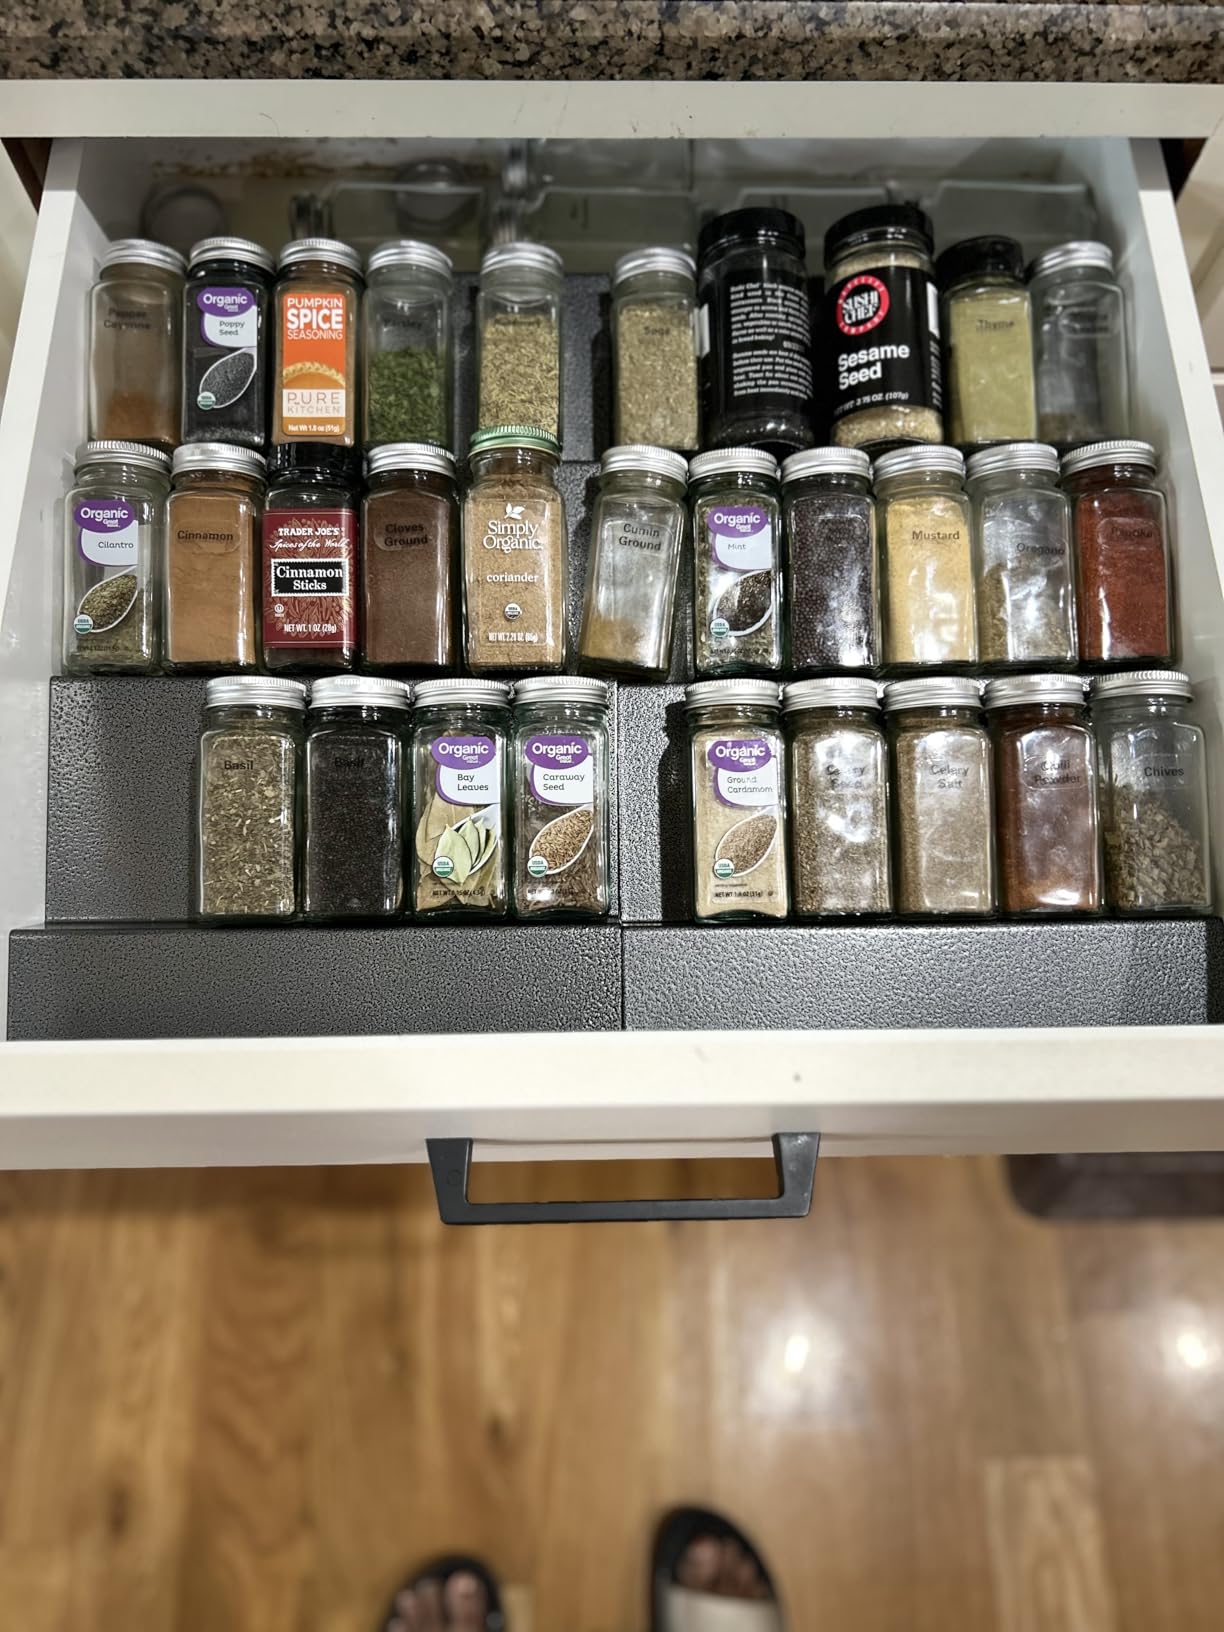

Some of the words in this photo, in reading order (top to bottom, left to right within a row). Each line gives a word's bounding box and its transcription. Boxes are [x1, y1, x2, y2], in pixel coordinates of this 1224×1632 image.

[203, 292, 248, 307] Organic
[288, 298, 342, 308] PUMPKIN
[220, 320, 246, 328] Poppy
[287, 308, 343, 330] SPICE
[978, 319, 1014, 330] Thyme
[288, 330, 343, 340] SEASONING
[838, 344, 910, 372] Sesame
[838, 361, 882, 390] Seed
[288, 392, 340, 404] PURE
[288, 406, 340, 414] KITCHEN
[80, 507, 128, 522] Organic
[714, 512, 760, 527] Organic
[278, 528, 314, 536] TRADER
[315, 528, 340, 536] JOE'S
[385, 523, 424, 534] Cloves
[488, 520, 539, 538] Simply
[624, 524, 660, 538] Cumin
[177, 530, 234, 542] Cinnamon
[384, 534, 428, 547] Ground
[912, 530, 960, 541] Mustard
[98, 541, 134, 549] Cilantro
[270, 539, 298, 552] Spices
[308, 539, 320, 548] the
[482, 535, 543, 554] Organic
[619, 536, 661, 550] Ground
[1016, 542, 1065, 557] Oregano
[276, 566, 343, 578] Cinnamon
[486, 572, 539, 582] coriander
[294, 580, 326, 590] Sticks
[284, 624, 294, 632] NET
[312, 624, 320, 632] OZ
[322, 624, 336, 633] (28g)
[438, 742, 488, 758] Organic
[532, 742, 582, 758] Organic
[716, 745, 766, 760] Organic
[224, 760, 254, 770] Basil
[335, 756, 364, 768] Basil
[826, 764, 866, 777] Cery
[930, 764, 969, 776] Celery
[1144, 766, 1184, 776] Chives
[458, 774, 474, 782] Bay
[543, 774, 584, 782] Caraway
[938, 779, 962, 789] Salt
[1034, 774, 1080, 784] Powder
